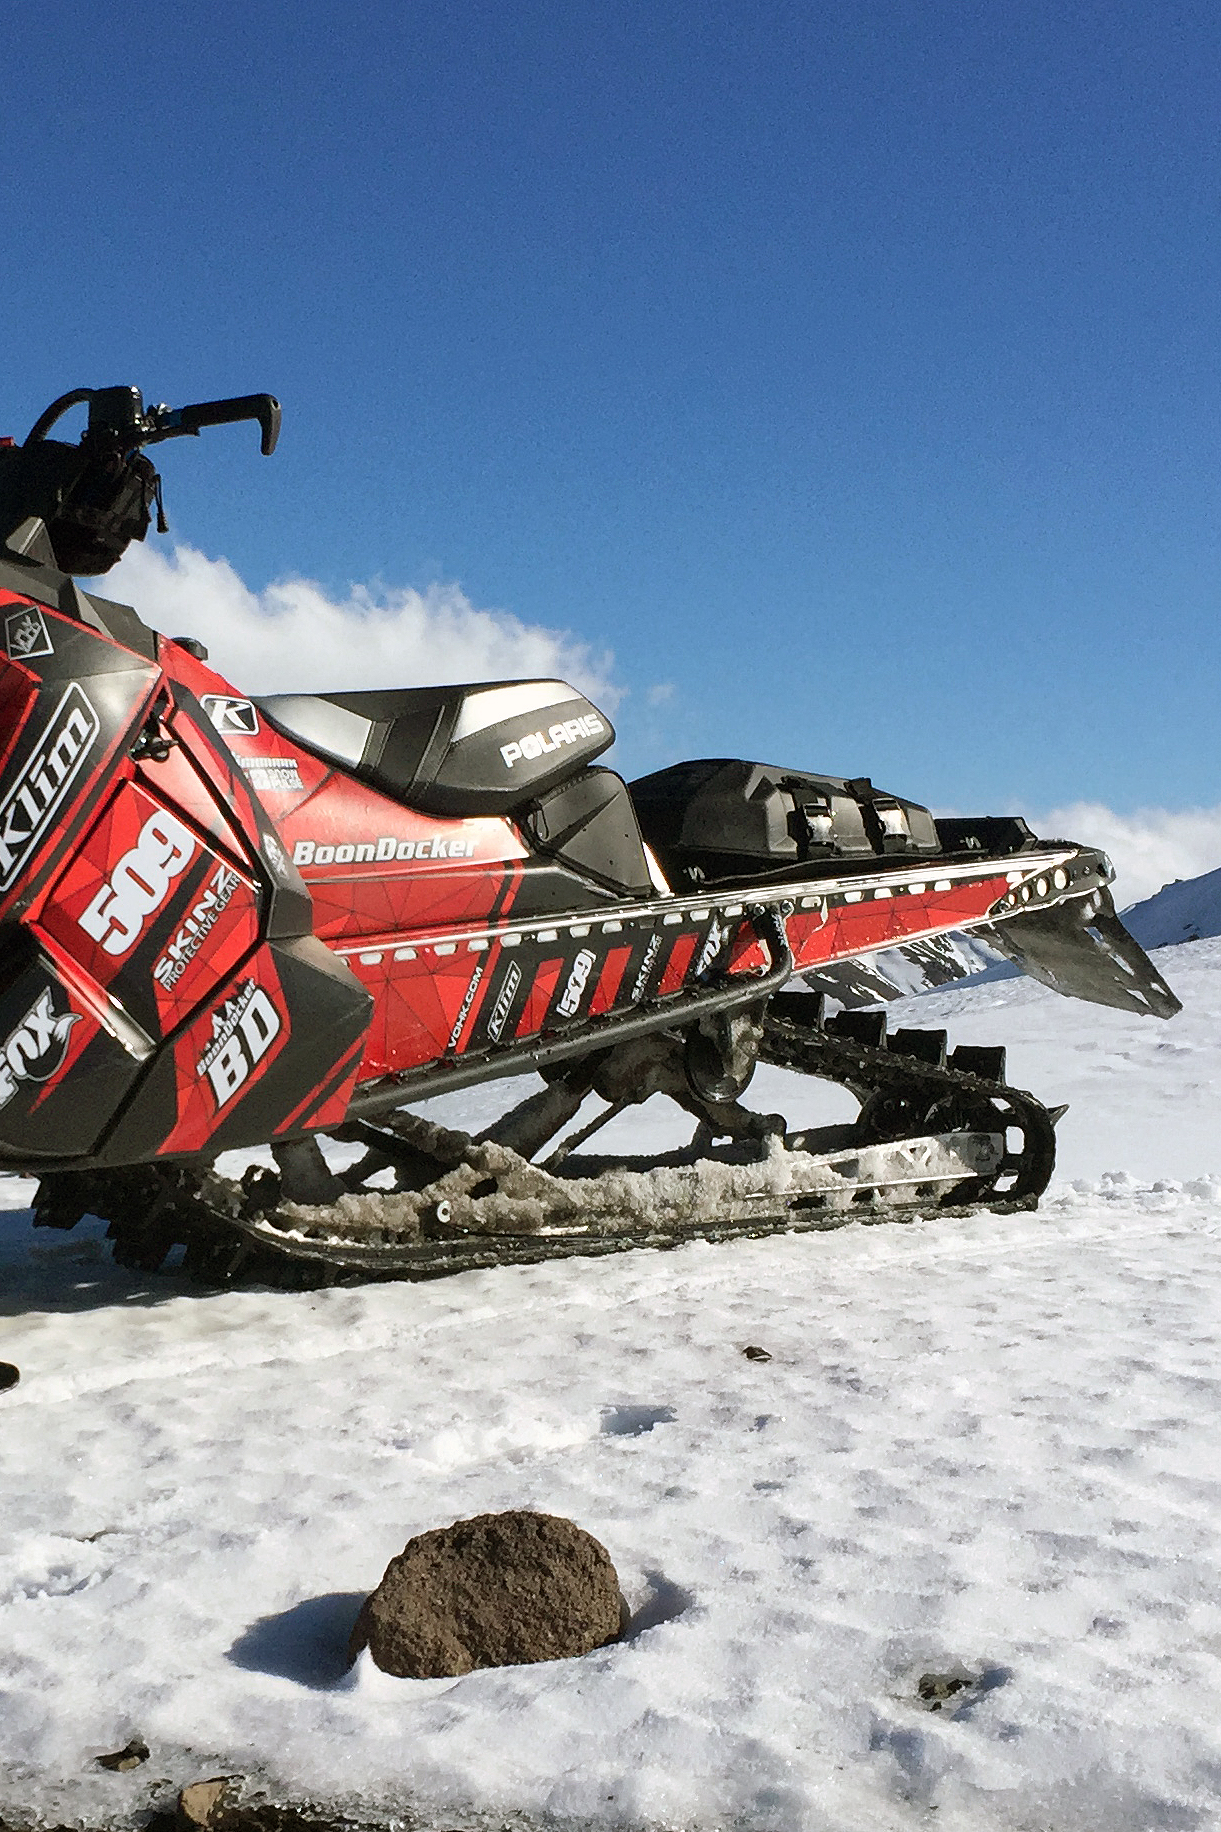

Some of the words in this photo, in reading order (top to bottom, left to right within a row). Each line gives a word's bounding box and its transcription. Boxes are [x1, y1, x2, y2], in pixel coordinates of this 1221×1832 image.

[499, 713, 604, 769] POLARIS
[77, 809, 196, 956] 509
[292, 834, 479, 866] BoonDocker
[153, 864, 234, 984] SKINZ
[162, 910, 219, 992] PROTECTIVE
[214, 873, 241, 912] GEAR
[207, 988, 280, 1109] BD
[447, 966, 484, 1048] VOHK.COM
